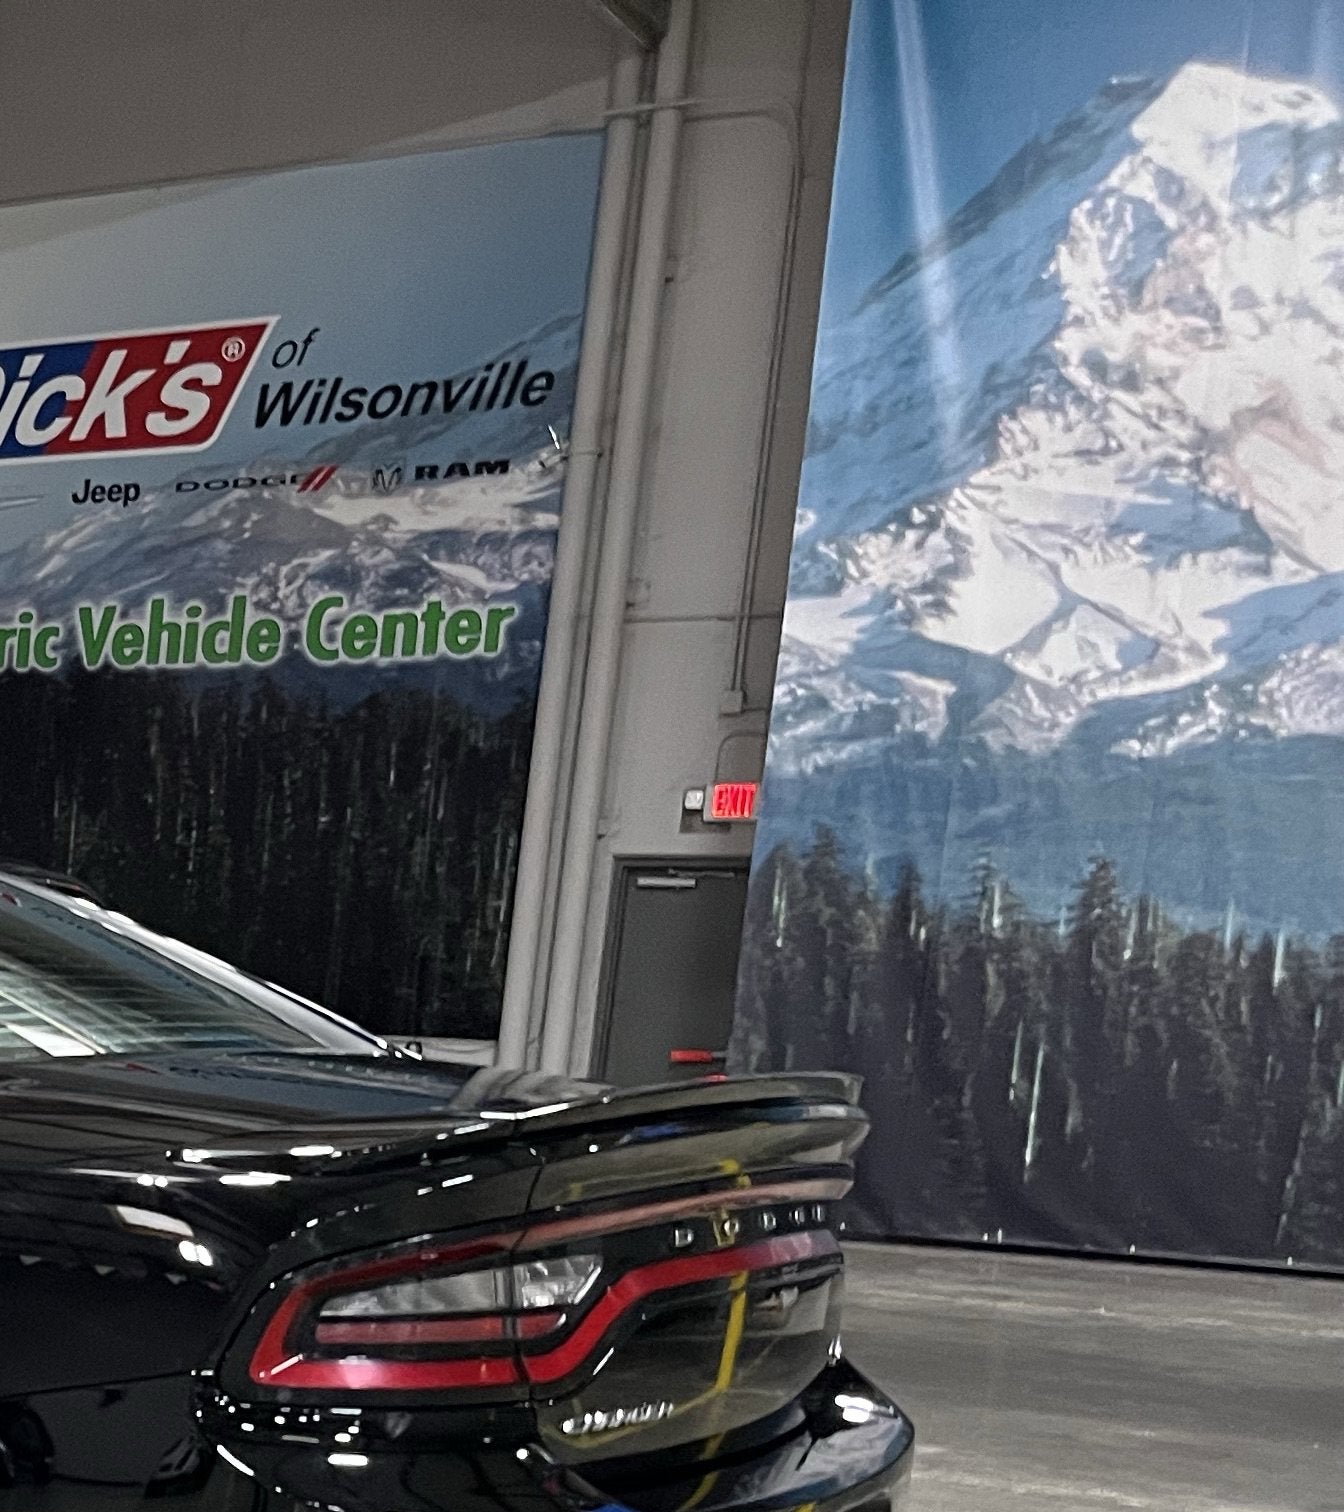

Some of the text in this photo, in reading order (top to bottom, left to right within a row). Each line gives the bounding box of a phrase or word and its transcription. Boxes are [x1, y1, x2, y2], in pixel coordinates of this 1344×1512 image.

[271, 328, 320, 369] of
[254, 359, 555, 428] Wilsonville
[71, 479, 140, 507] Jeep
[414, 459, 510, 482] RAM
[78, 596, 282, 667] Vehicle
[305, 596, 515, 661] Center
[714, 784, 756, 817] EXIT
